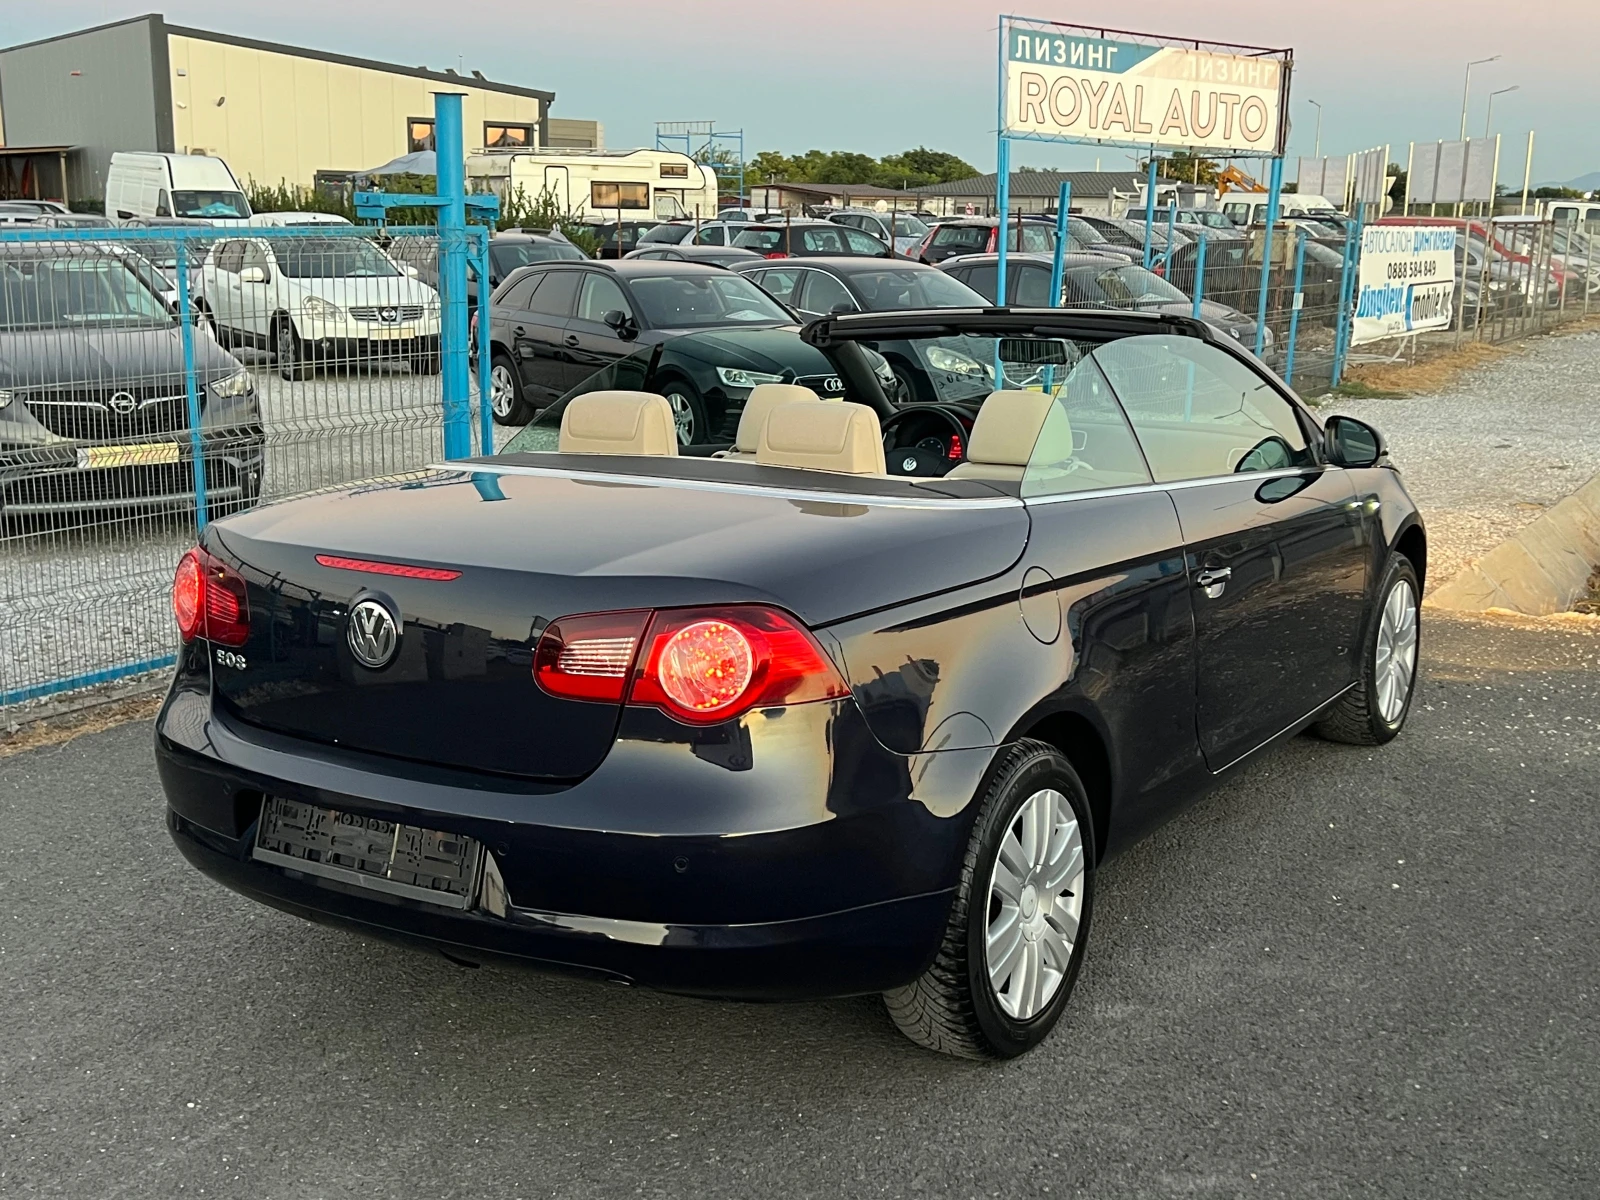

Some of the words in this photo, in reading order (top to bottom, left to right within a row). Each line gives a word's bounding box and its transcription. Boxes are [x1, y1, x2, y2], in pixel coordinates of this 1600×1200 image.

[1015, 35, 1118, 69] ЛИЗИНГ
[1182, 56, 1276, 86] ЛИЗИНГ
[1019, 71, 1153, 134] ROYAL
[1159, 88, 1268, 142] AUTO
[1363, 231, 1412, 254] АВТОСАЛОН
[1387, 262, 1407, 279] 0888
[1409, 261, 1422, 278] 584
[1424, 260, 1436, 276] 849
[216, 649, 248, 671] EOS
